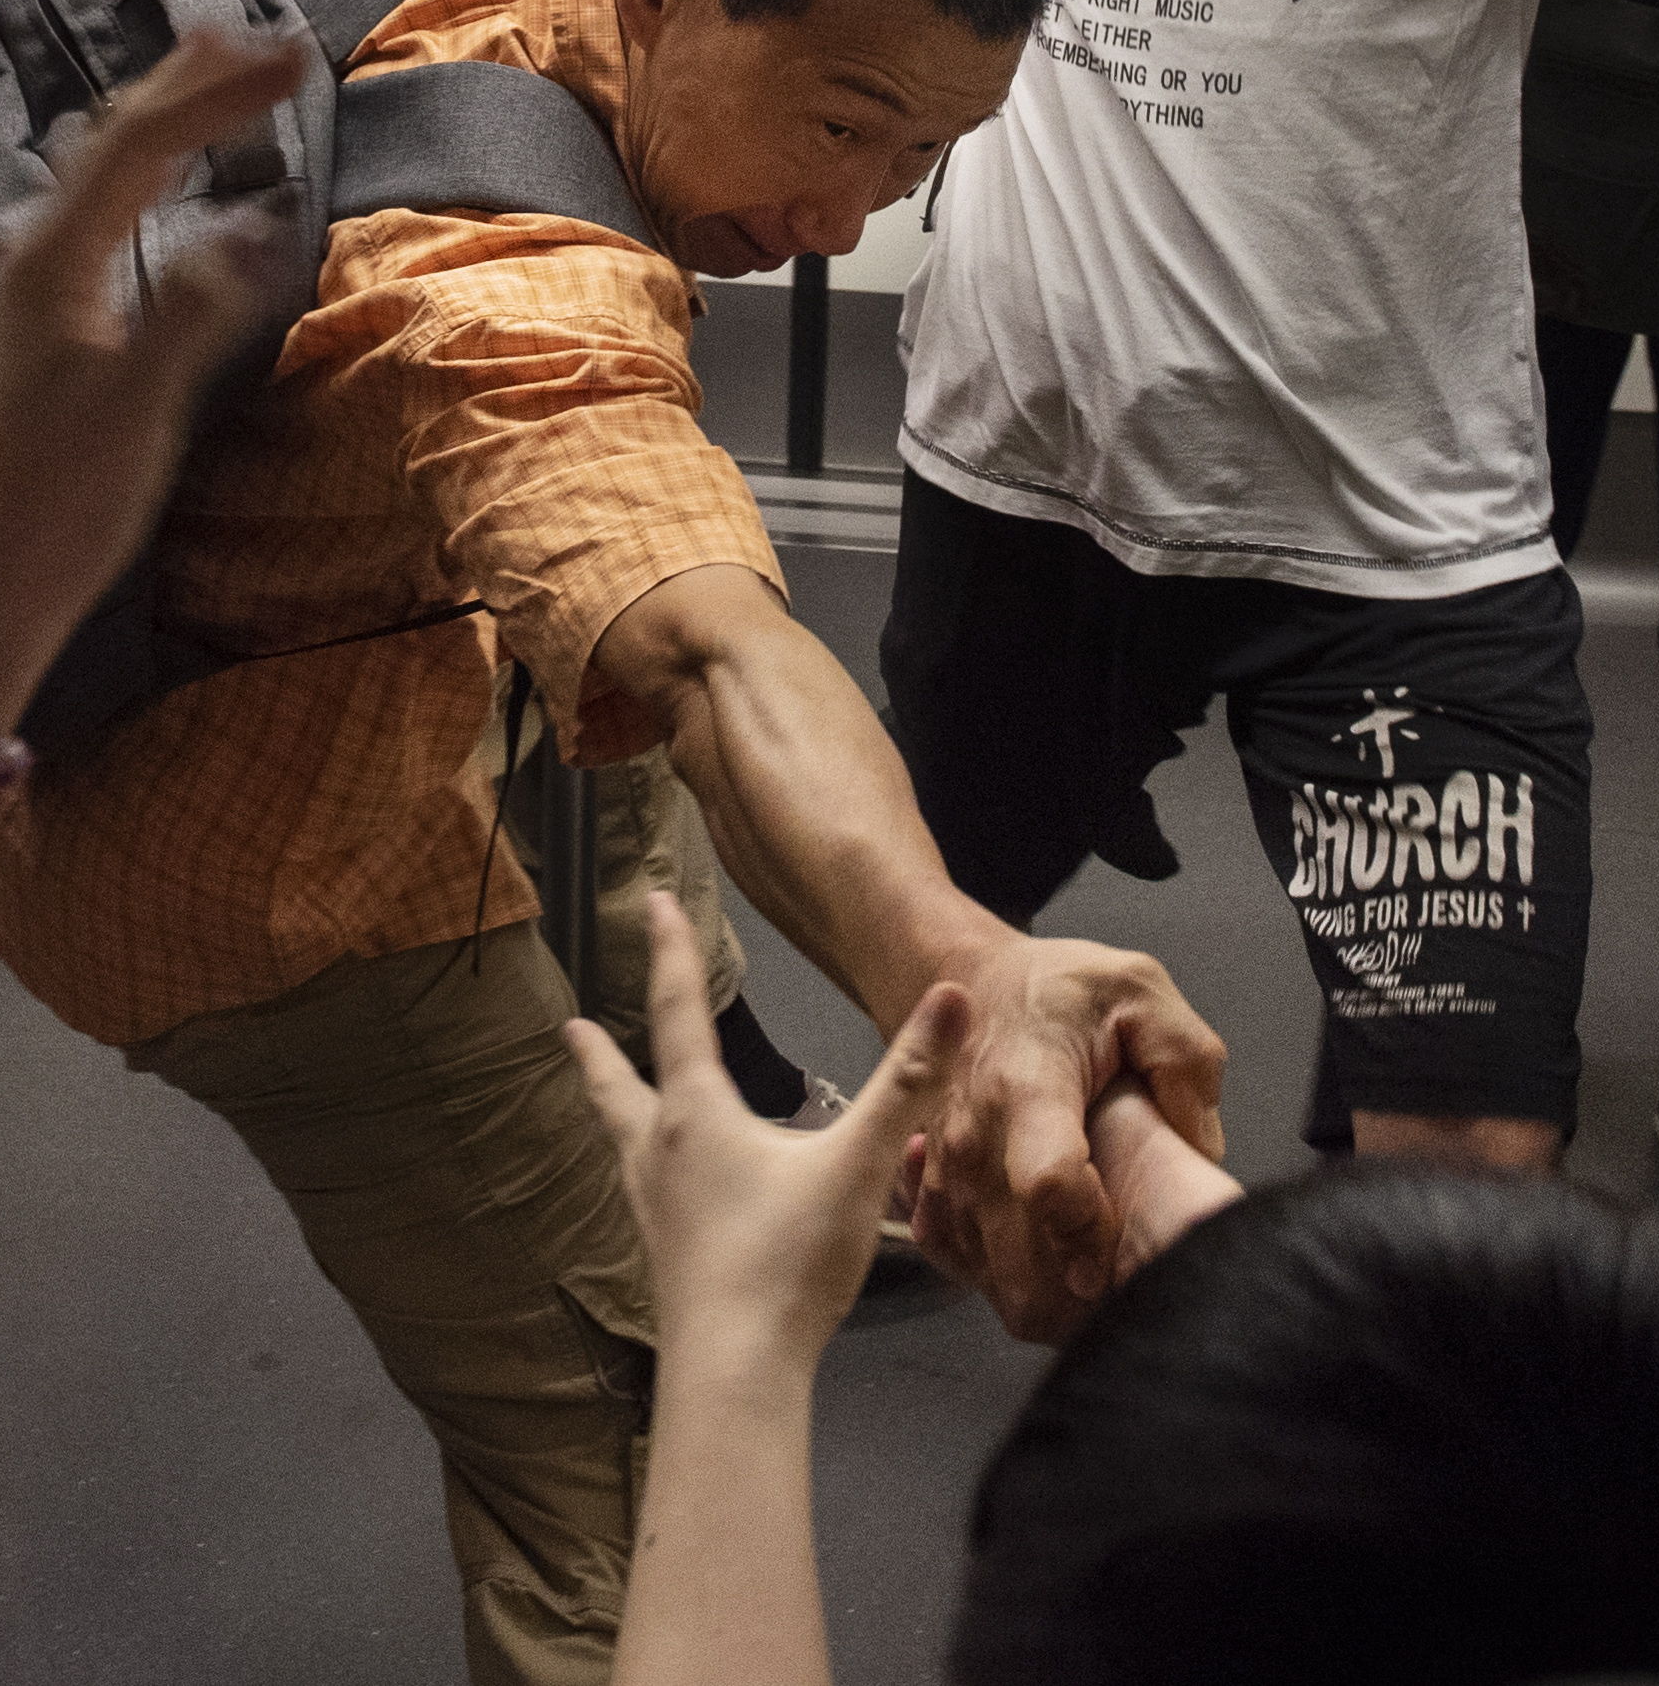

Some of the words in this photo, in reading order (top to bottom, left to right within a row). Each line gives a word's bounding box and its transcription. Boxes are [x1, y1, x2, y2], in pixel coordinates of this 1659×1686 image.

[1042, 0, 1063, 23] ET
[1080, 19, 1152, 51] EITHER
[1160, 68, 1188, 92] OR
[1201, 72, 1243, 96] YOU
[1287, 770, 1535, 900] CHURCH
[1362, 892, 1409, 934] FOR
[1417, 889, 1504, 930] JESUS
